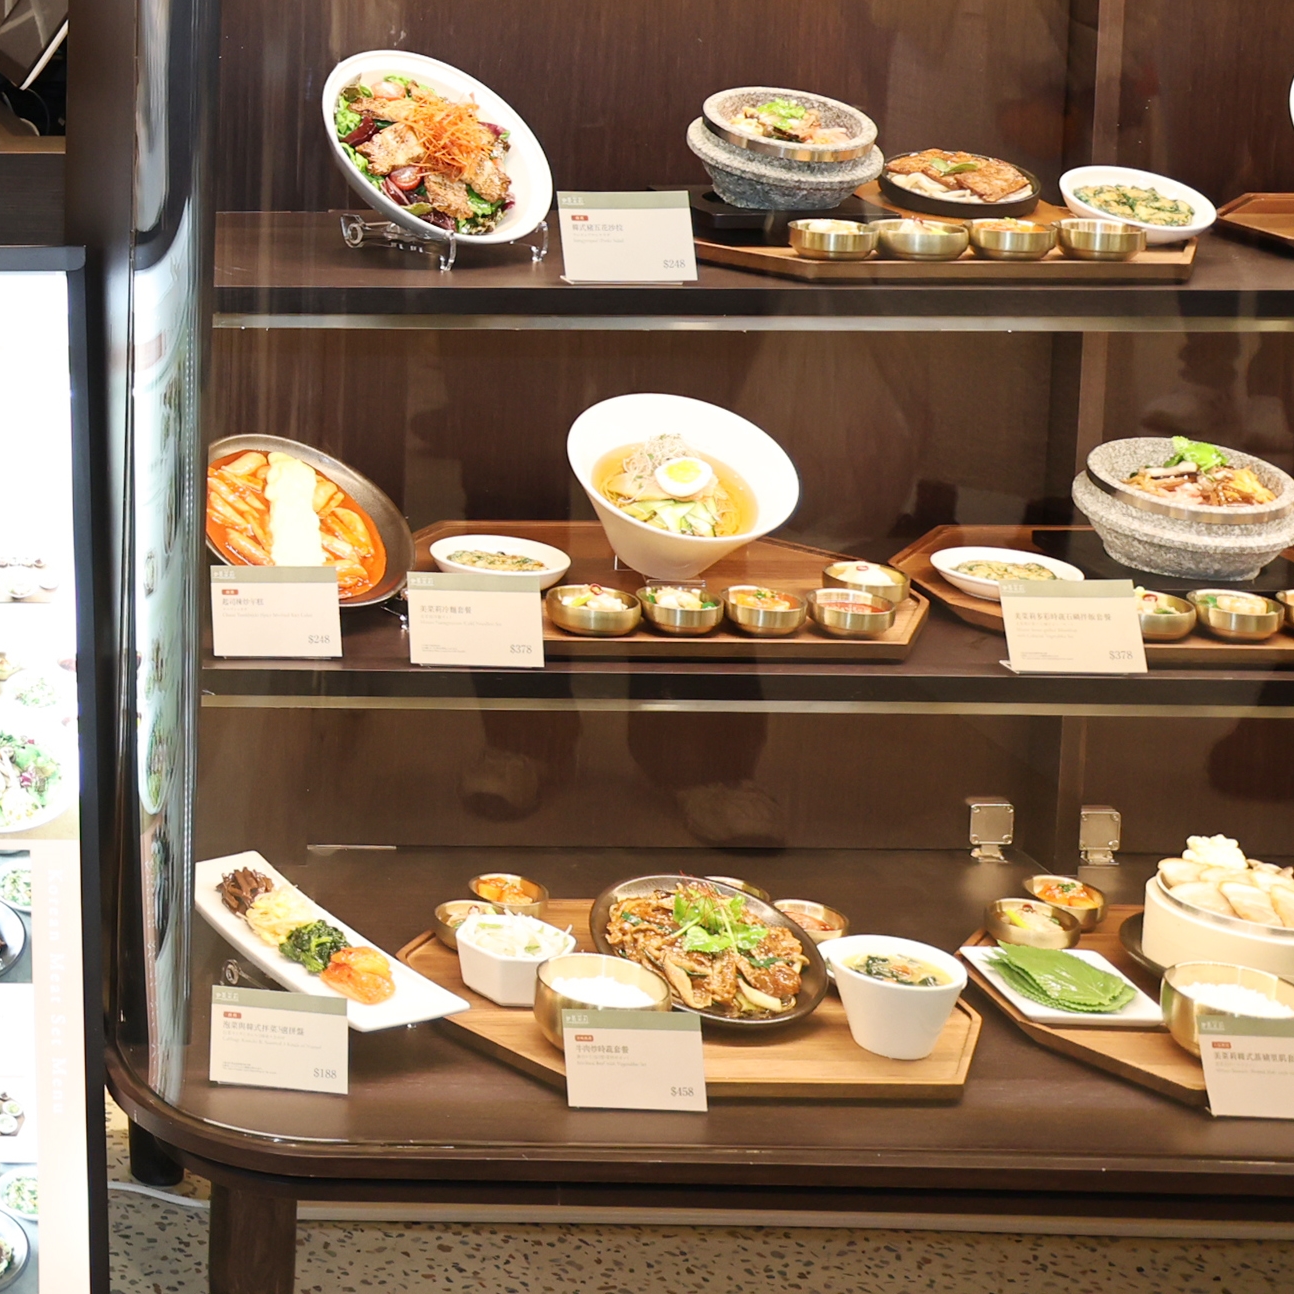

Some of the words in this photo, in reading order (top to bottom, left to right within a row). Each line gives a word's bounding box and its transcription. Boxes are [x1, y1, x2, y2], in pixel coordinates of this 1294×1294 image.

[662, 259, 687, 269] $248
[308, 634, 331, 645] $248
[509, 644, 533, 655] $378
[1109, 650, 1134, 661] $378
[47, 868, 64, 942] Korean
[48, 952, 66, 1004] Meat
[50, 1013, 67, 1046] Set
[313, 1068, 338, 1080] $188
[51, 1056, 68, 1115] Menu
[670, 1086, 695, 1098] $458
